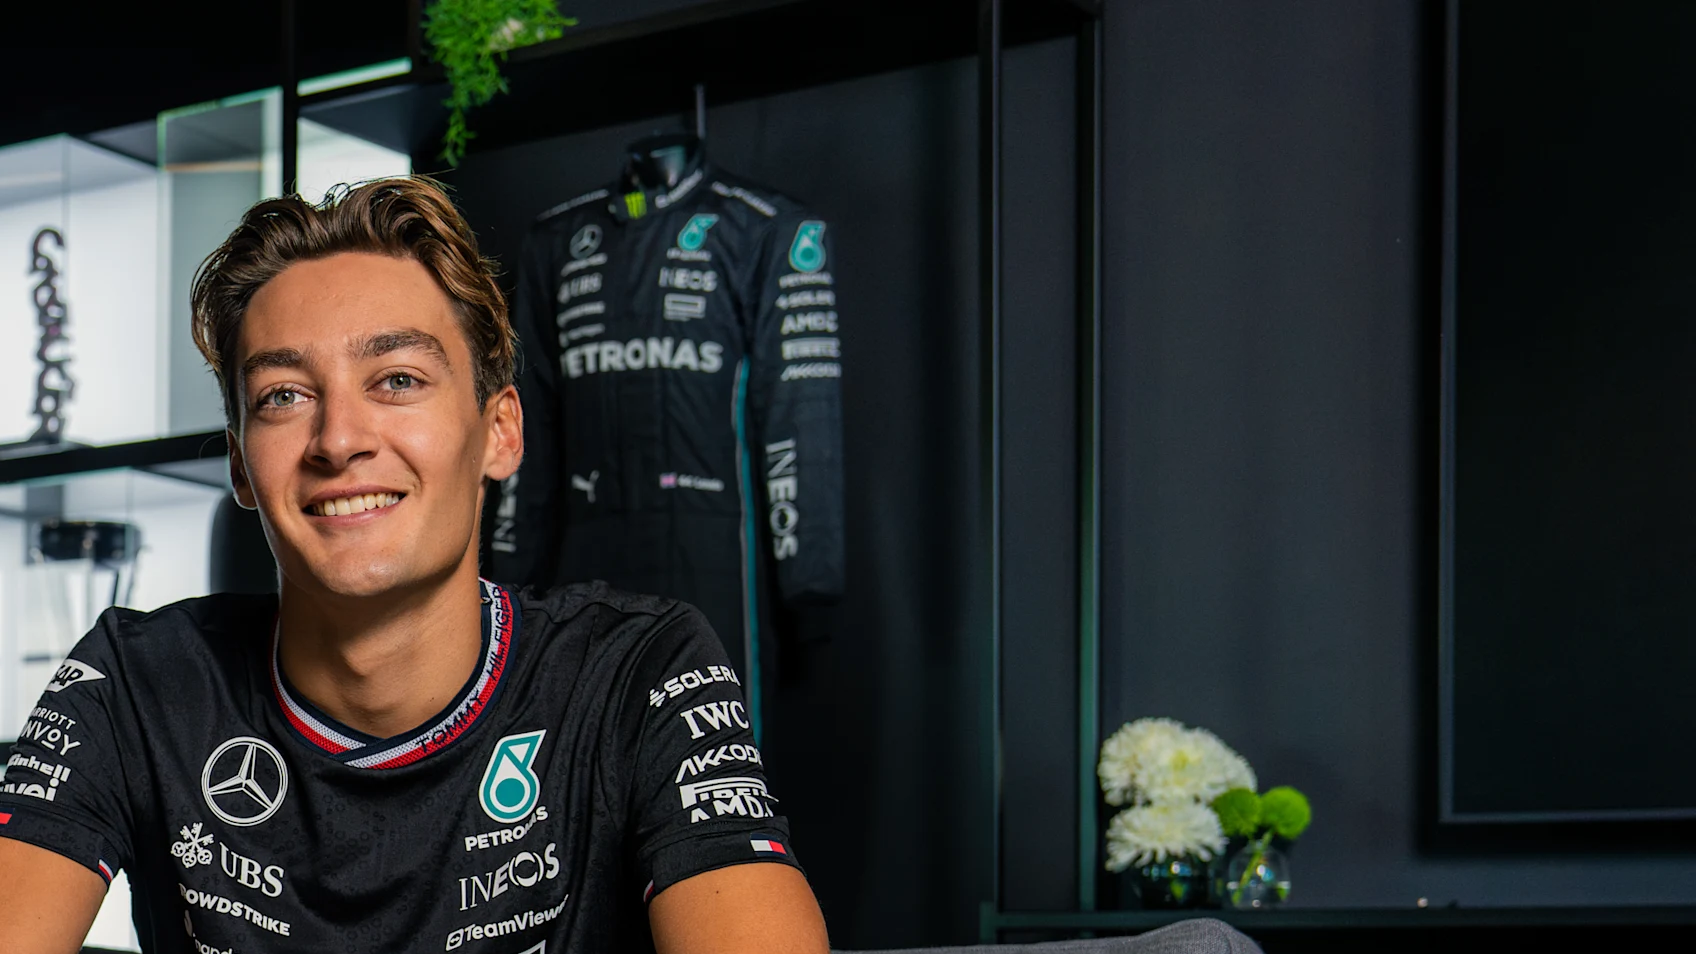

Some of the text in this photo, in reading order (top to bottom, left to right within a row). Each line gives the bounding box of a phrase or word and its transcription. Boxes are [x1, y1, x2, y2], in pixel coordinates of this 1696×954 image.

[765, 438, 798, 561] INEOS
[416, 586, 511, 753] TOMMY HILFIGER
[21, 719, 81, 756] NVOY
[31, 706, 76, 730] RRIOTT
[680, 700, 750, 740] IWC
[219, 841, 285, 898] UBS
[458, 842, 560, 911] INEOS
[178, 882, 291, 937] ROWDSTRIKE
